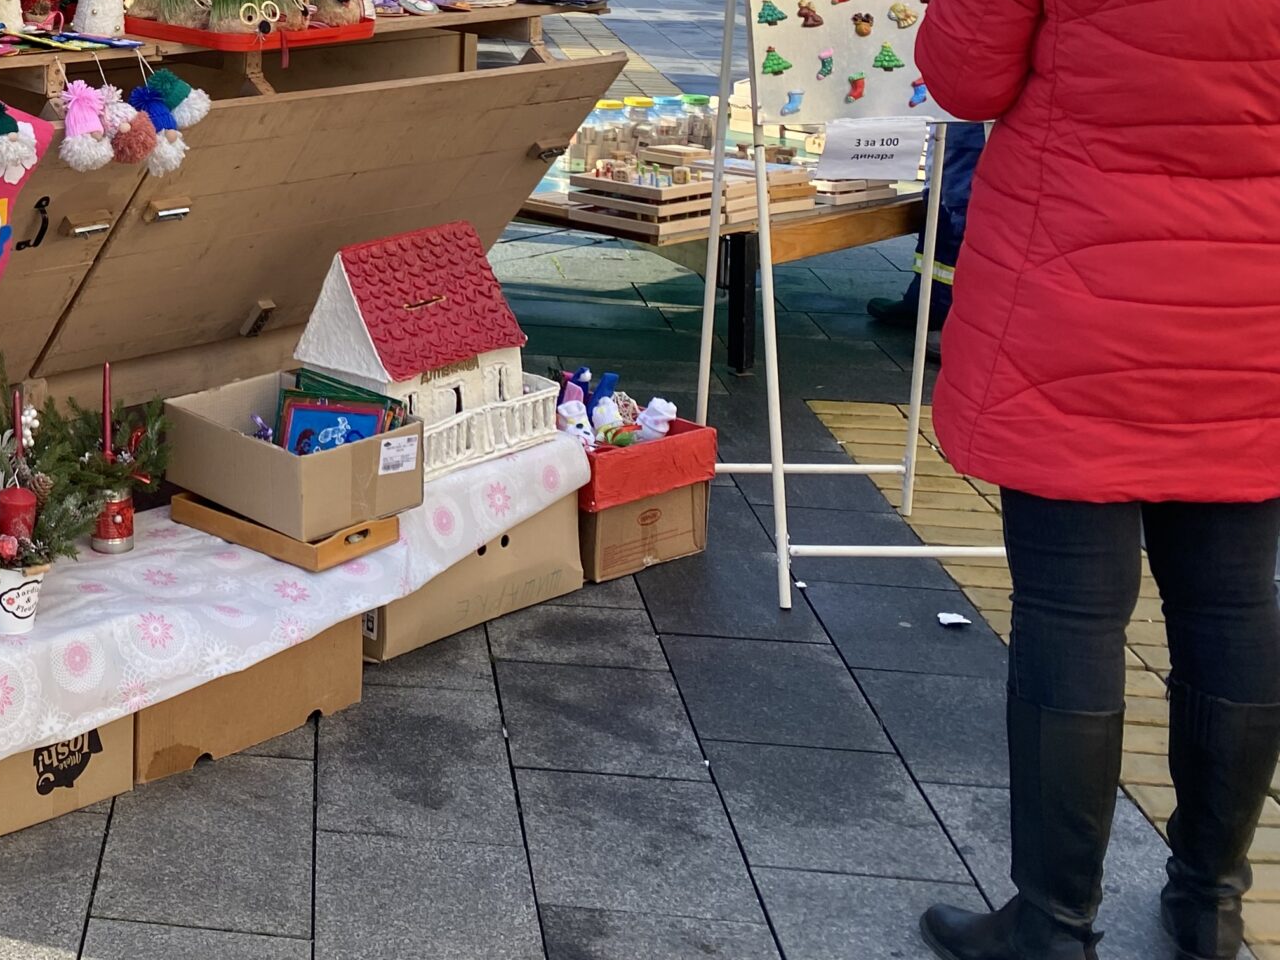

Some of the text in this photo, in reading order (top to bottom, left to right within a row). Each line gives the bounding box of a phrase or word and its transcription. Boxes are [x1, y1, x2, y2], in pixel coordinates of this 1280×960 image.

[854, 137, 899, 147] 3 за 100
[851, 153, 894, 161] динара
[38, 731, 90, 773] Josh!
